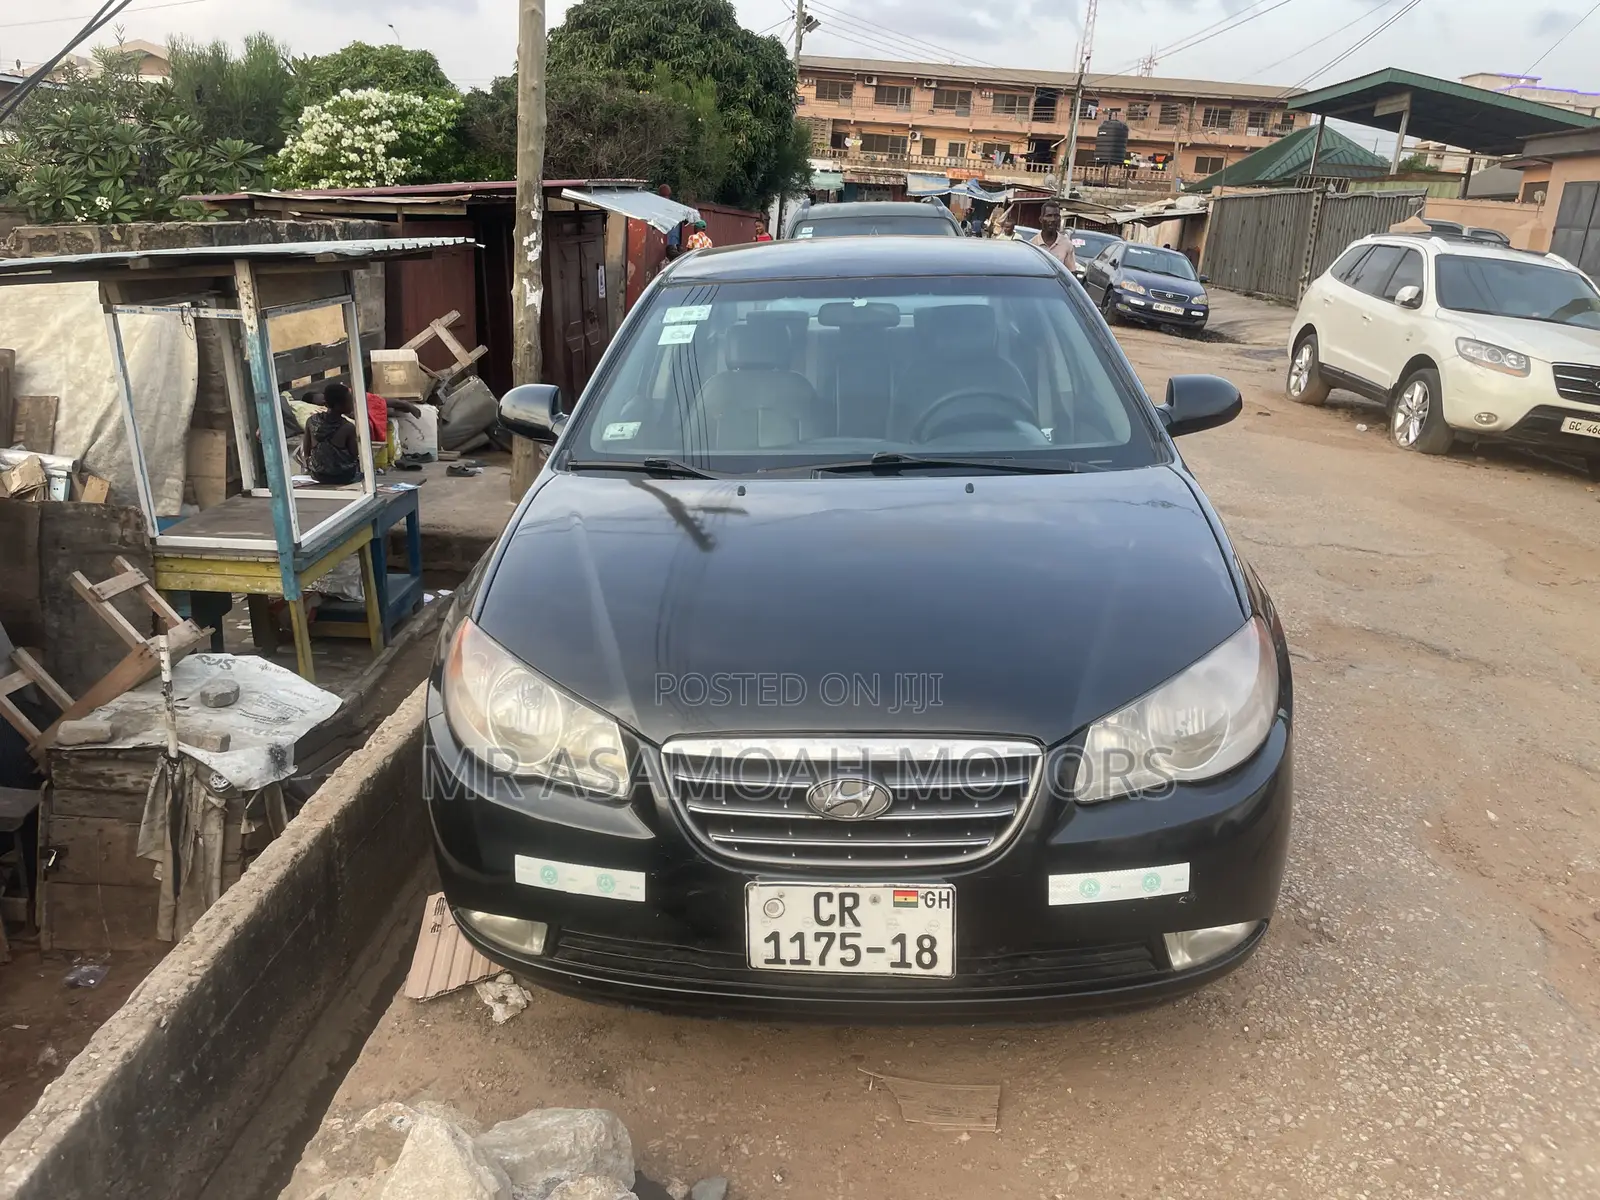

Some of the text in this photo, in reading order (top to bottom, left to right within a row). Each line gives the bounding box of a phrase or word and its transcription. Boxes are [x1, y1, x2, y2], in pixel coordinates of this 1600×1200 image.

[1569, 421, 1582, 431] GC
[813, 892, 861, 928] CR
[924, 891, 950, 909] GH
[763, 931, 938, 970] 1175-18
